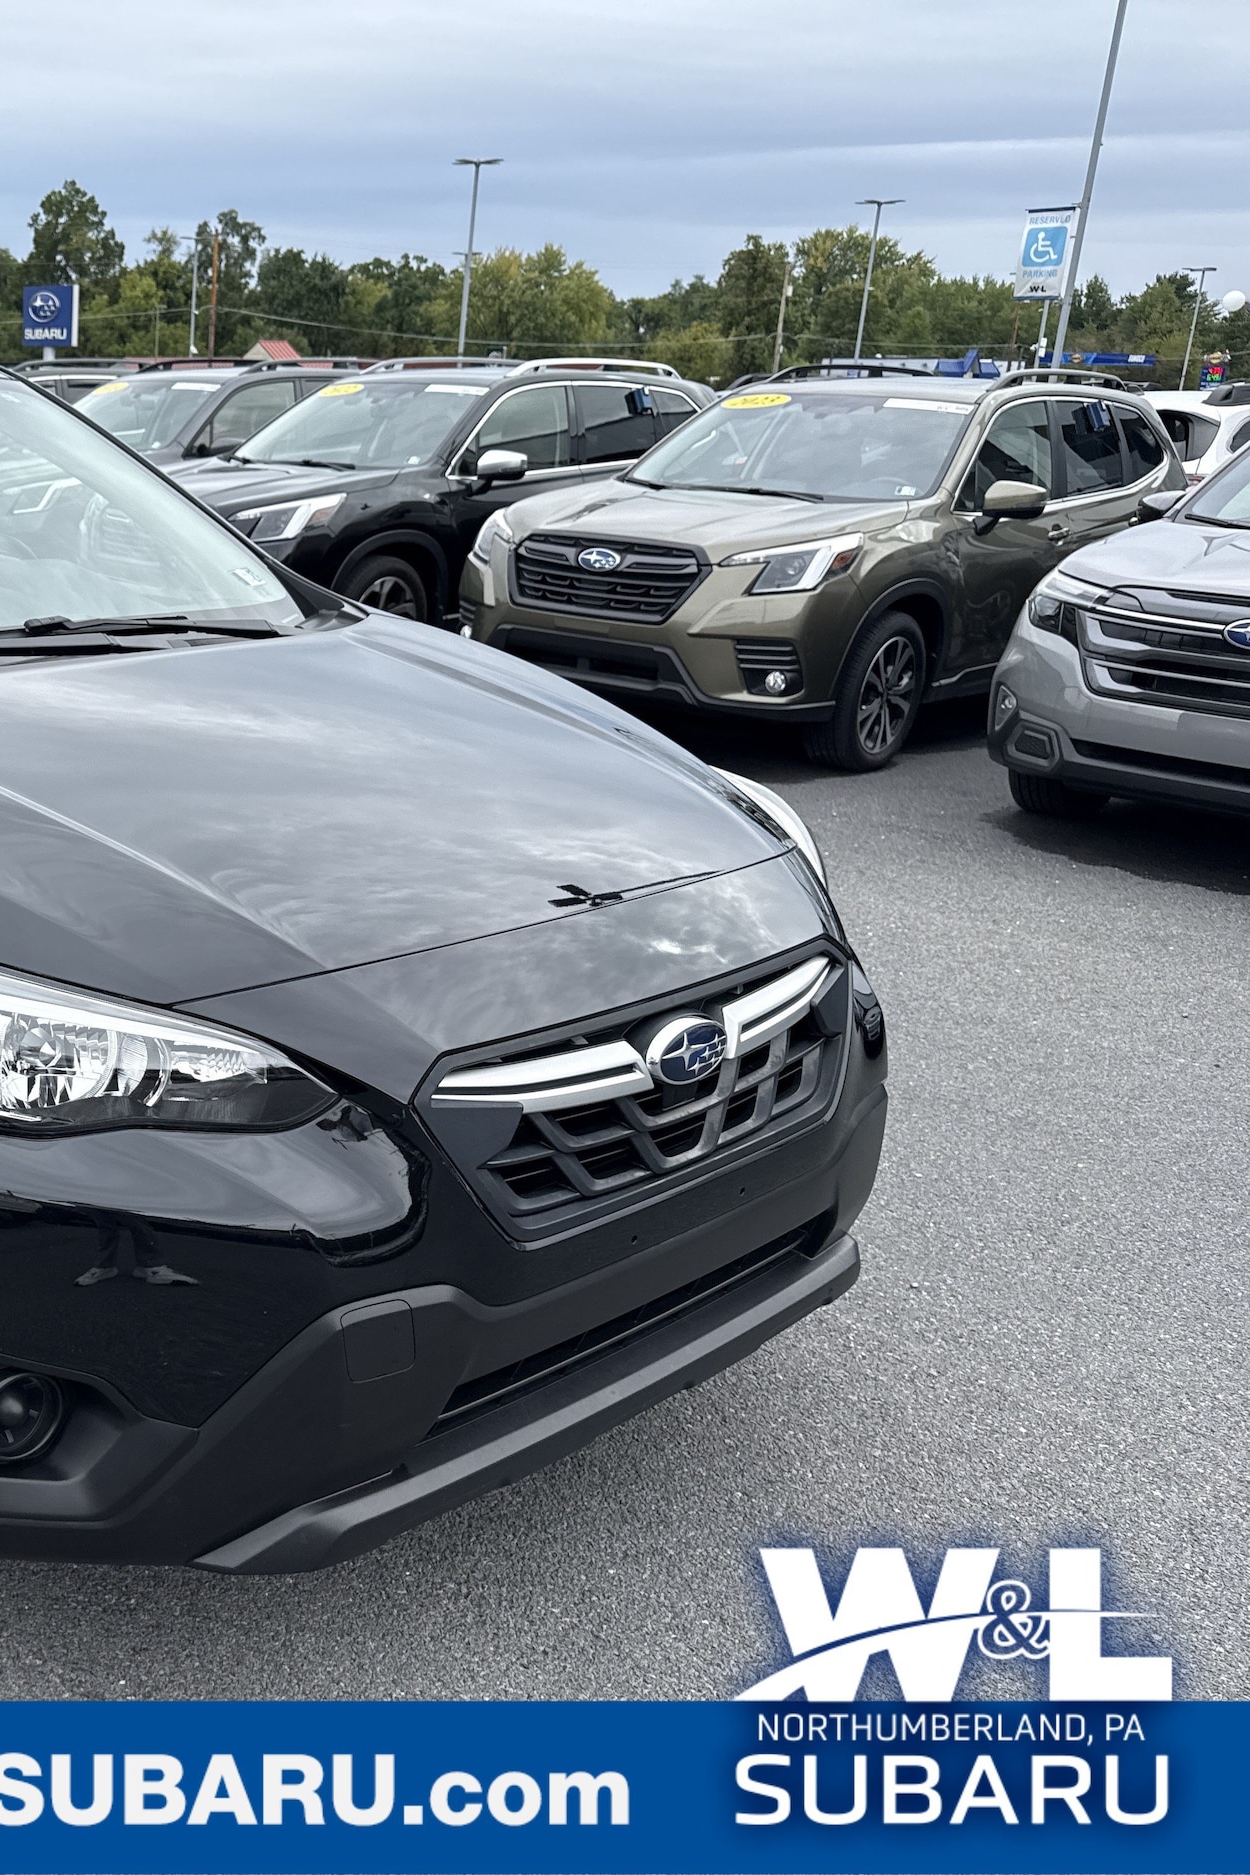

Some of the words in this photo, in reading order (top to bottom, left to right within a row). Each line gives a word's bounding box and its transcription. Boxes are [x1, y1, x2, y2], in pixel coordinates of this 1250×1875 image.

[1029, 214, 1071, 225] RESERVED
[1022, 269, 1058, 279] PARKING
[24, 327, 68, 340] SUBARU
